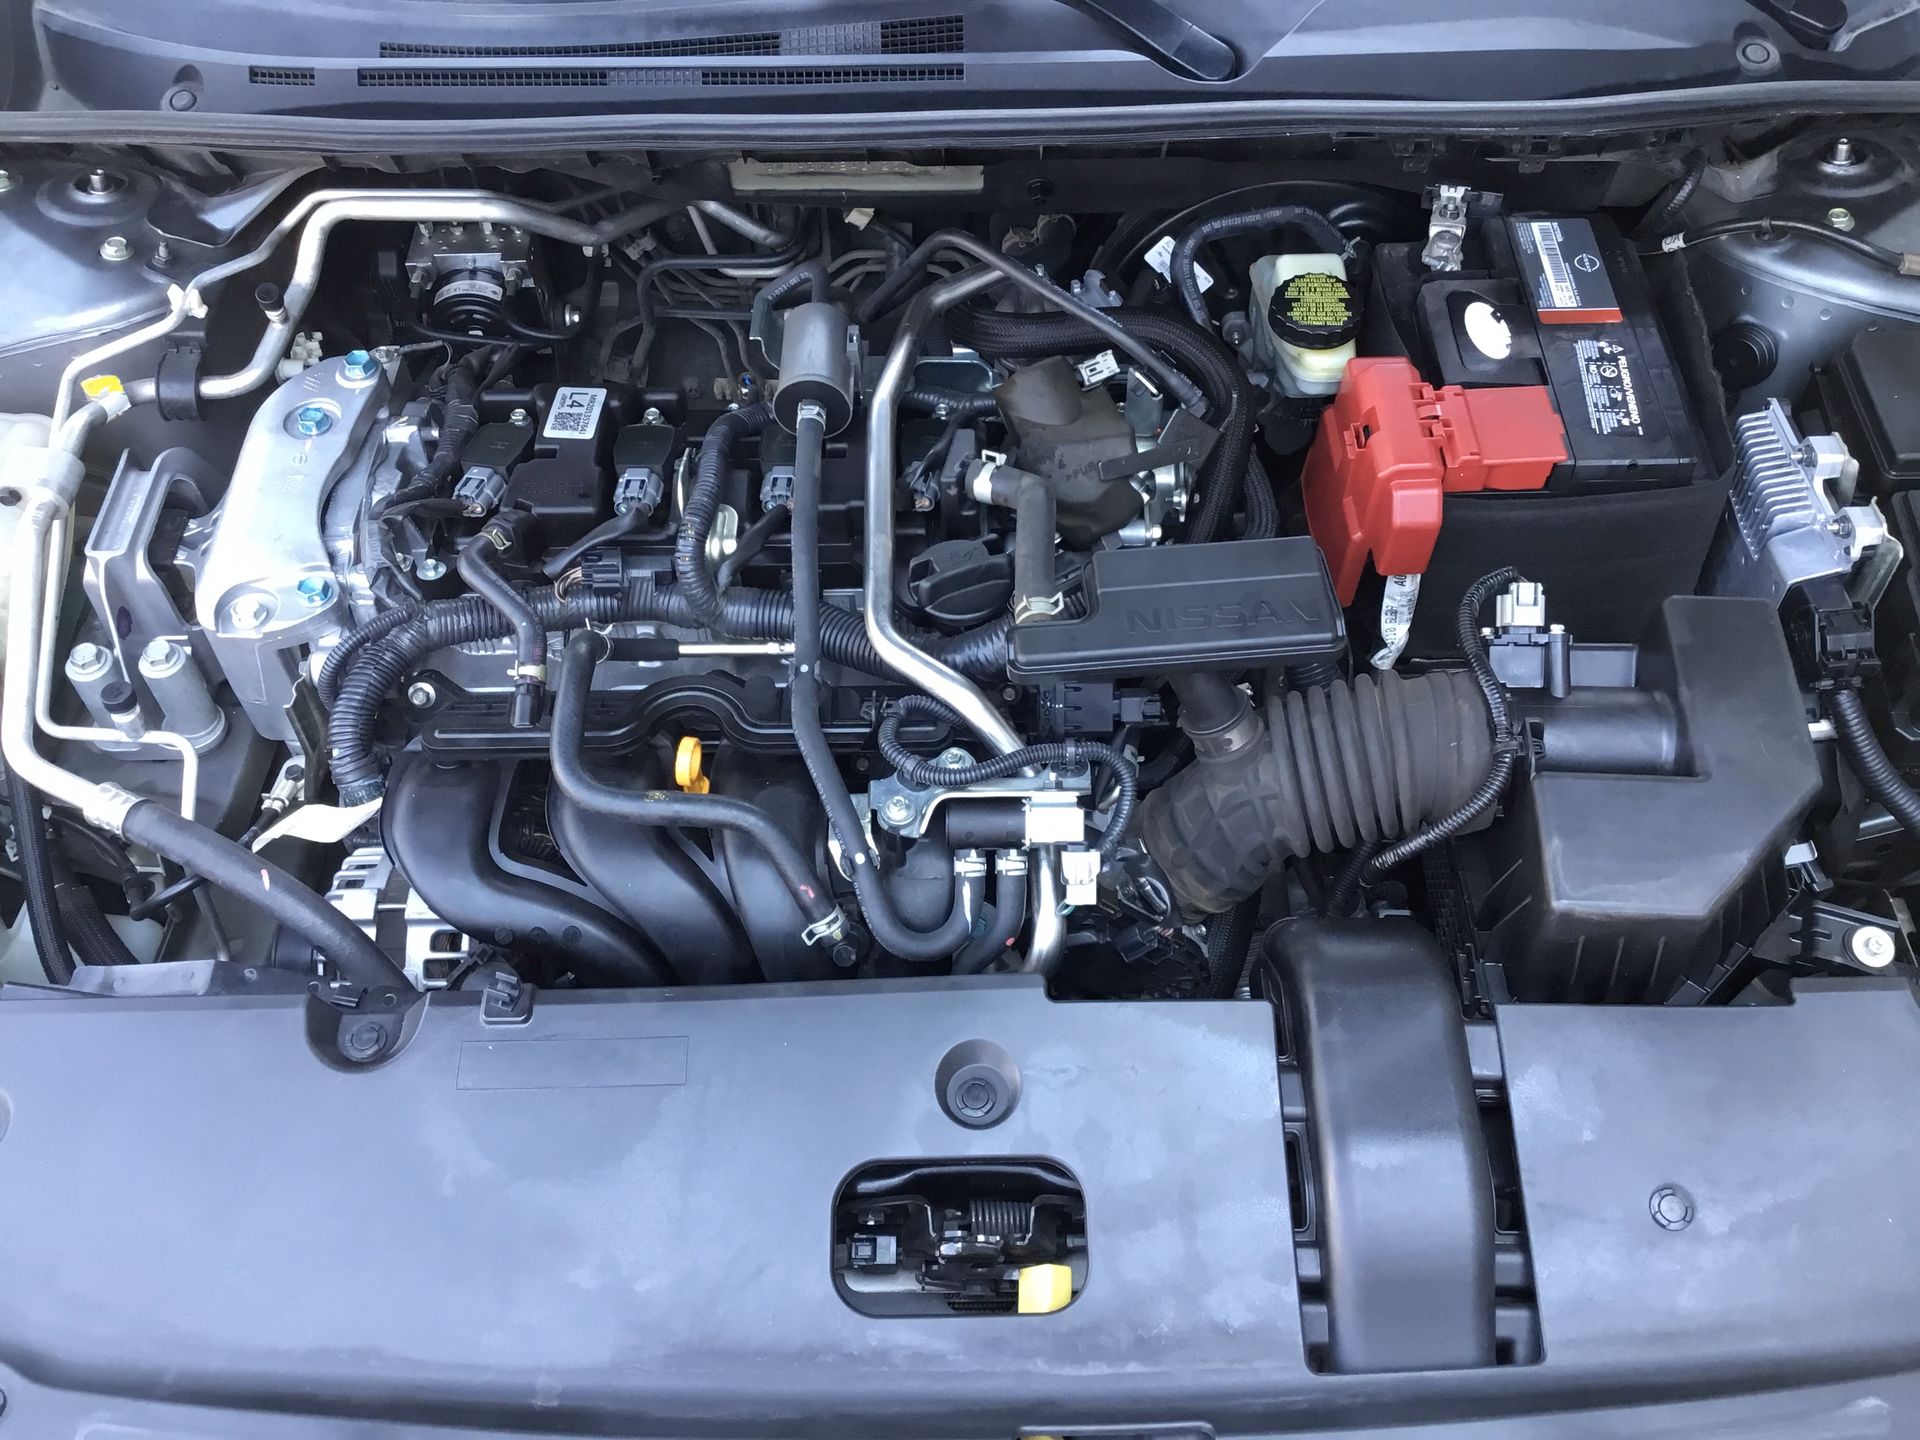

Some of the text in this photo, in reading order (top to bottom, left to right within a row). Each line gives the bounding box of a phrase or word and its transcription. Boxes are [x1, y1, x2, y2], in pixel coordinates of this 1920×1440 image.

[1582, 253, 1593, 273] NISSAN
[566, 392, 589, 409] L4
[1617, 355, 1642, 424] PELIGRO/VENENO
[1126, 601, 1321, 634] NISSAN
